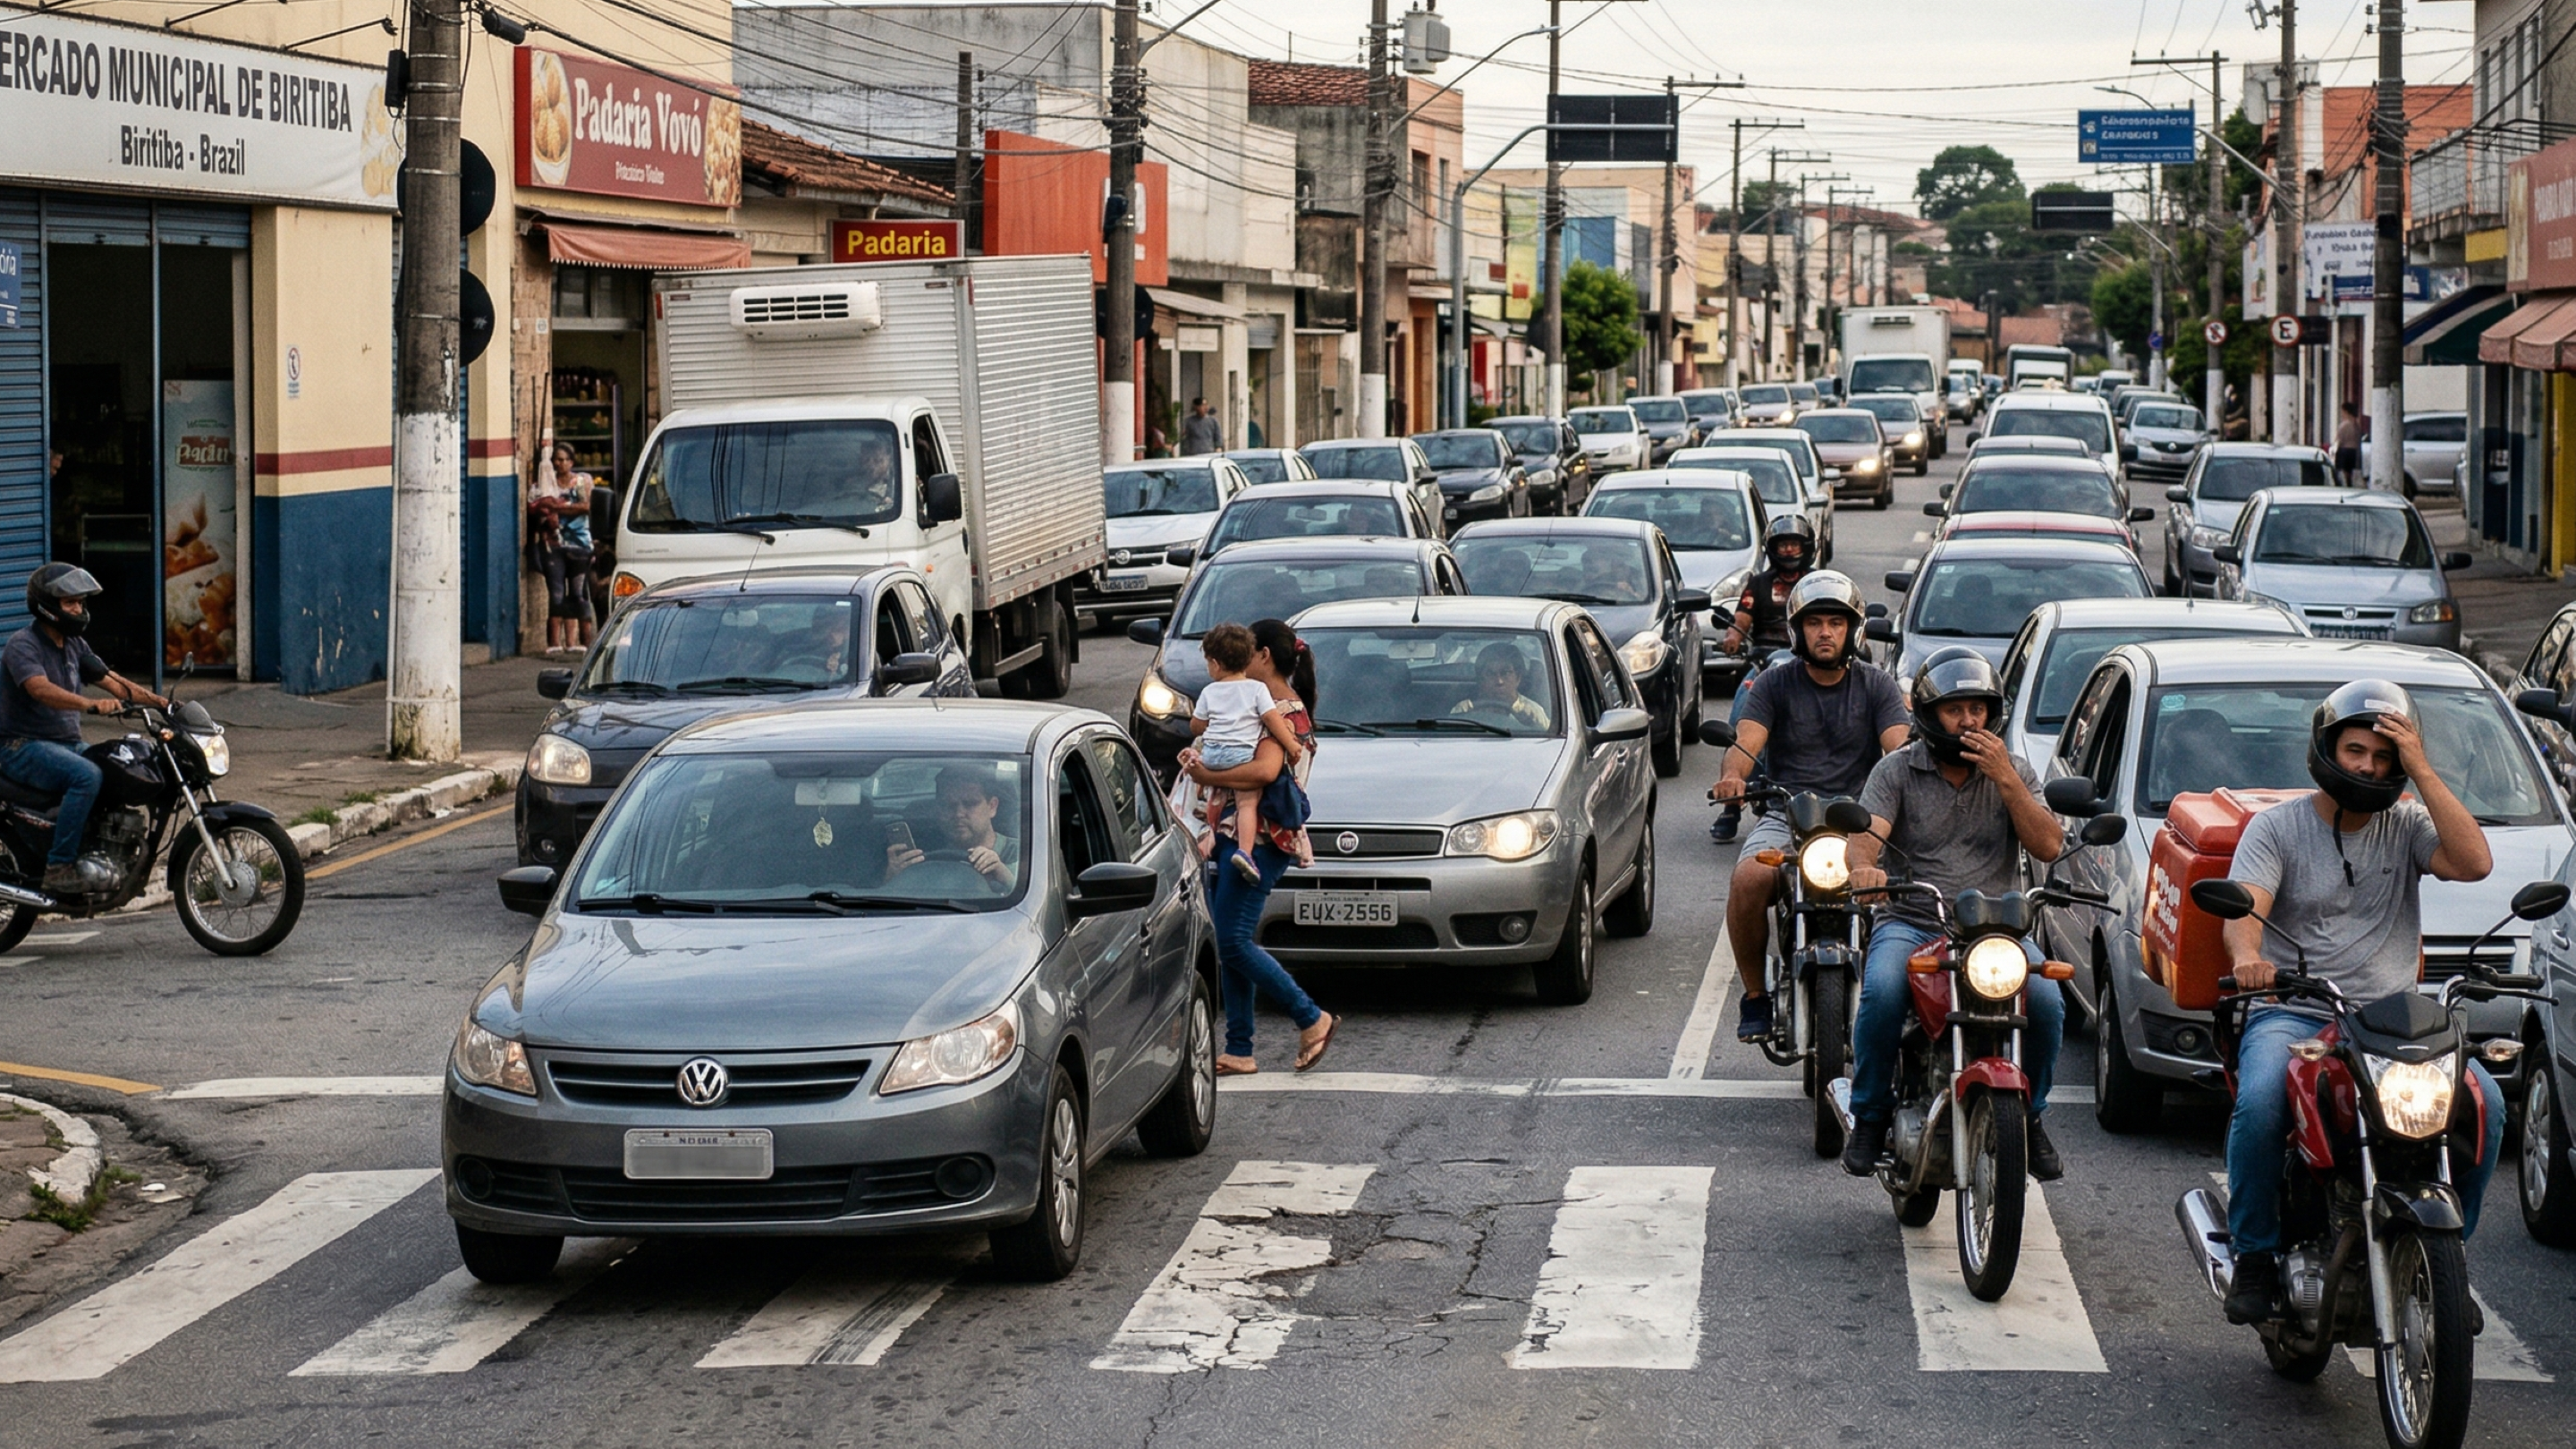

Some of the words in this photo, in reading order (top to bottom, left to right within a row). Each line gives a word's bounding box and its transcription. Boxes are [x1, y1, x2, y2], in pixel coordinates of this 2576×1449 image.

[108, 46, 232, 116] MUNICIPAL
[237, 66, 263, 121] DE
[269, 72, 352, 132] BIRITIBA
[573, 77, 653, 150] Padaria
[656, 90, 702, 157] Vovó
[121, 124, 184, 171] Biritiba
[199, 133, 246, 175] Brazil
[848, 229, 946, 255] Padaria
